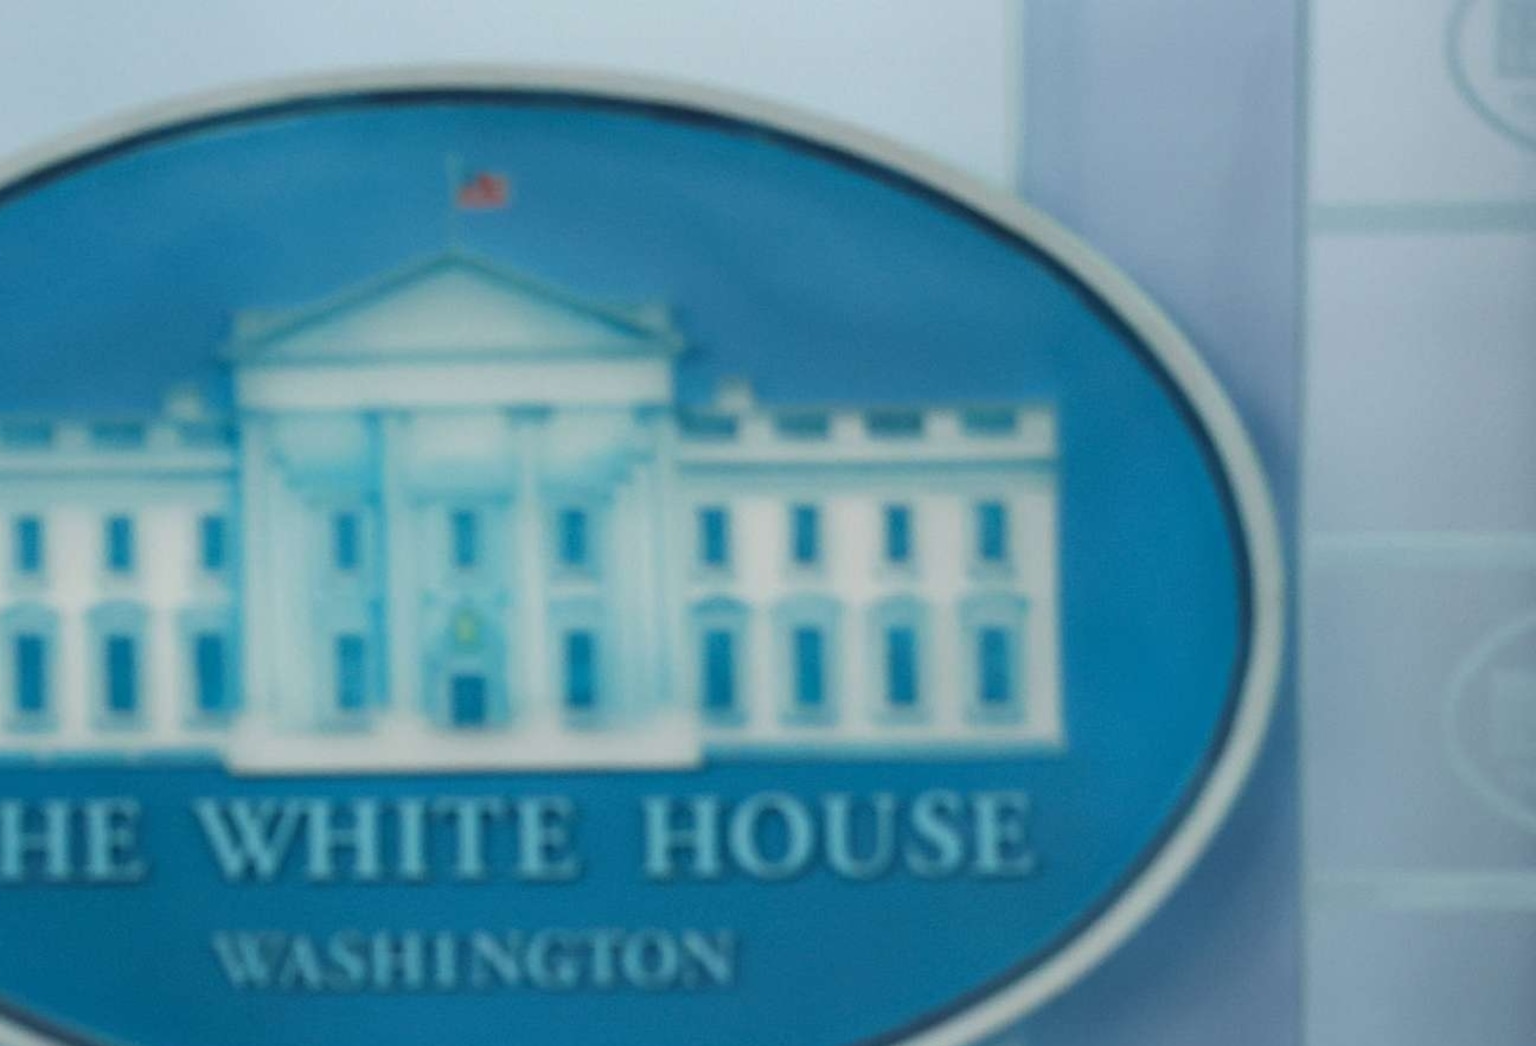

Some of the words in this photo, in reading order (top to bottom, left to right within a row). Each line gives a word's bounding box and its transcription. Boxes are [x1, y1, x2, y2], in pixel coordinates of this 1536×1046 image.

[195, 796, 578, 882] WHITE
[644, 791, 1035, 879] HOUSE
[212, 928, 736, 990] WASHINGTON
